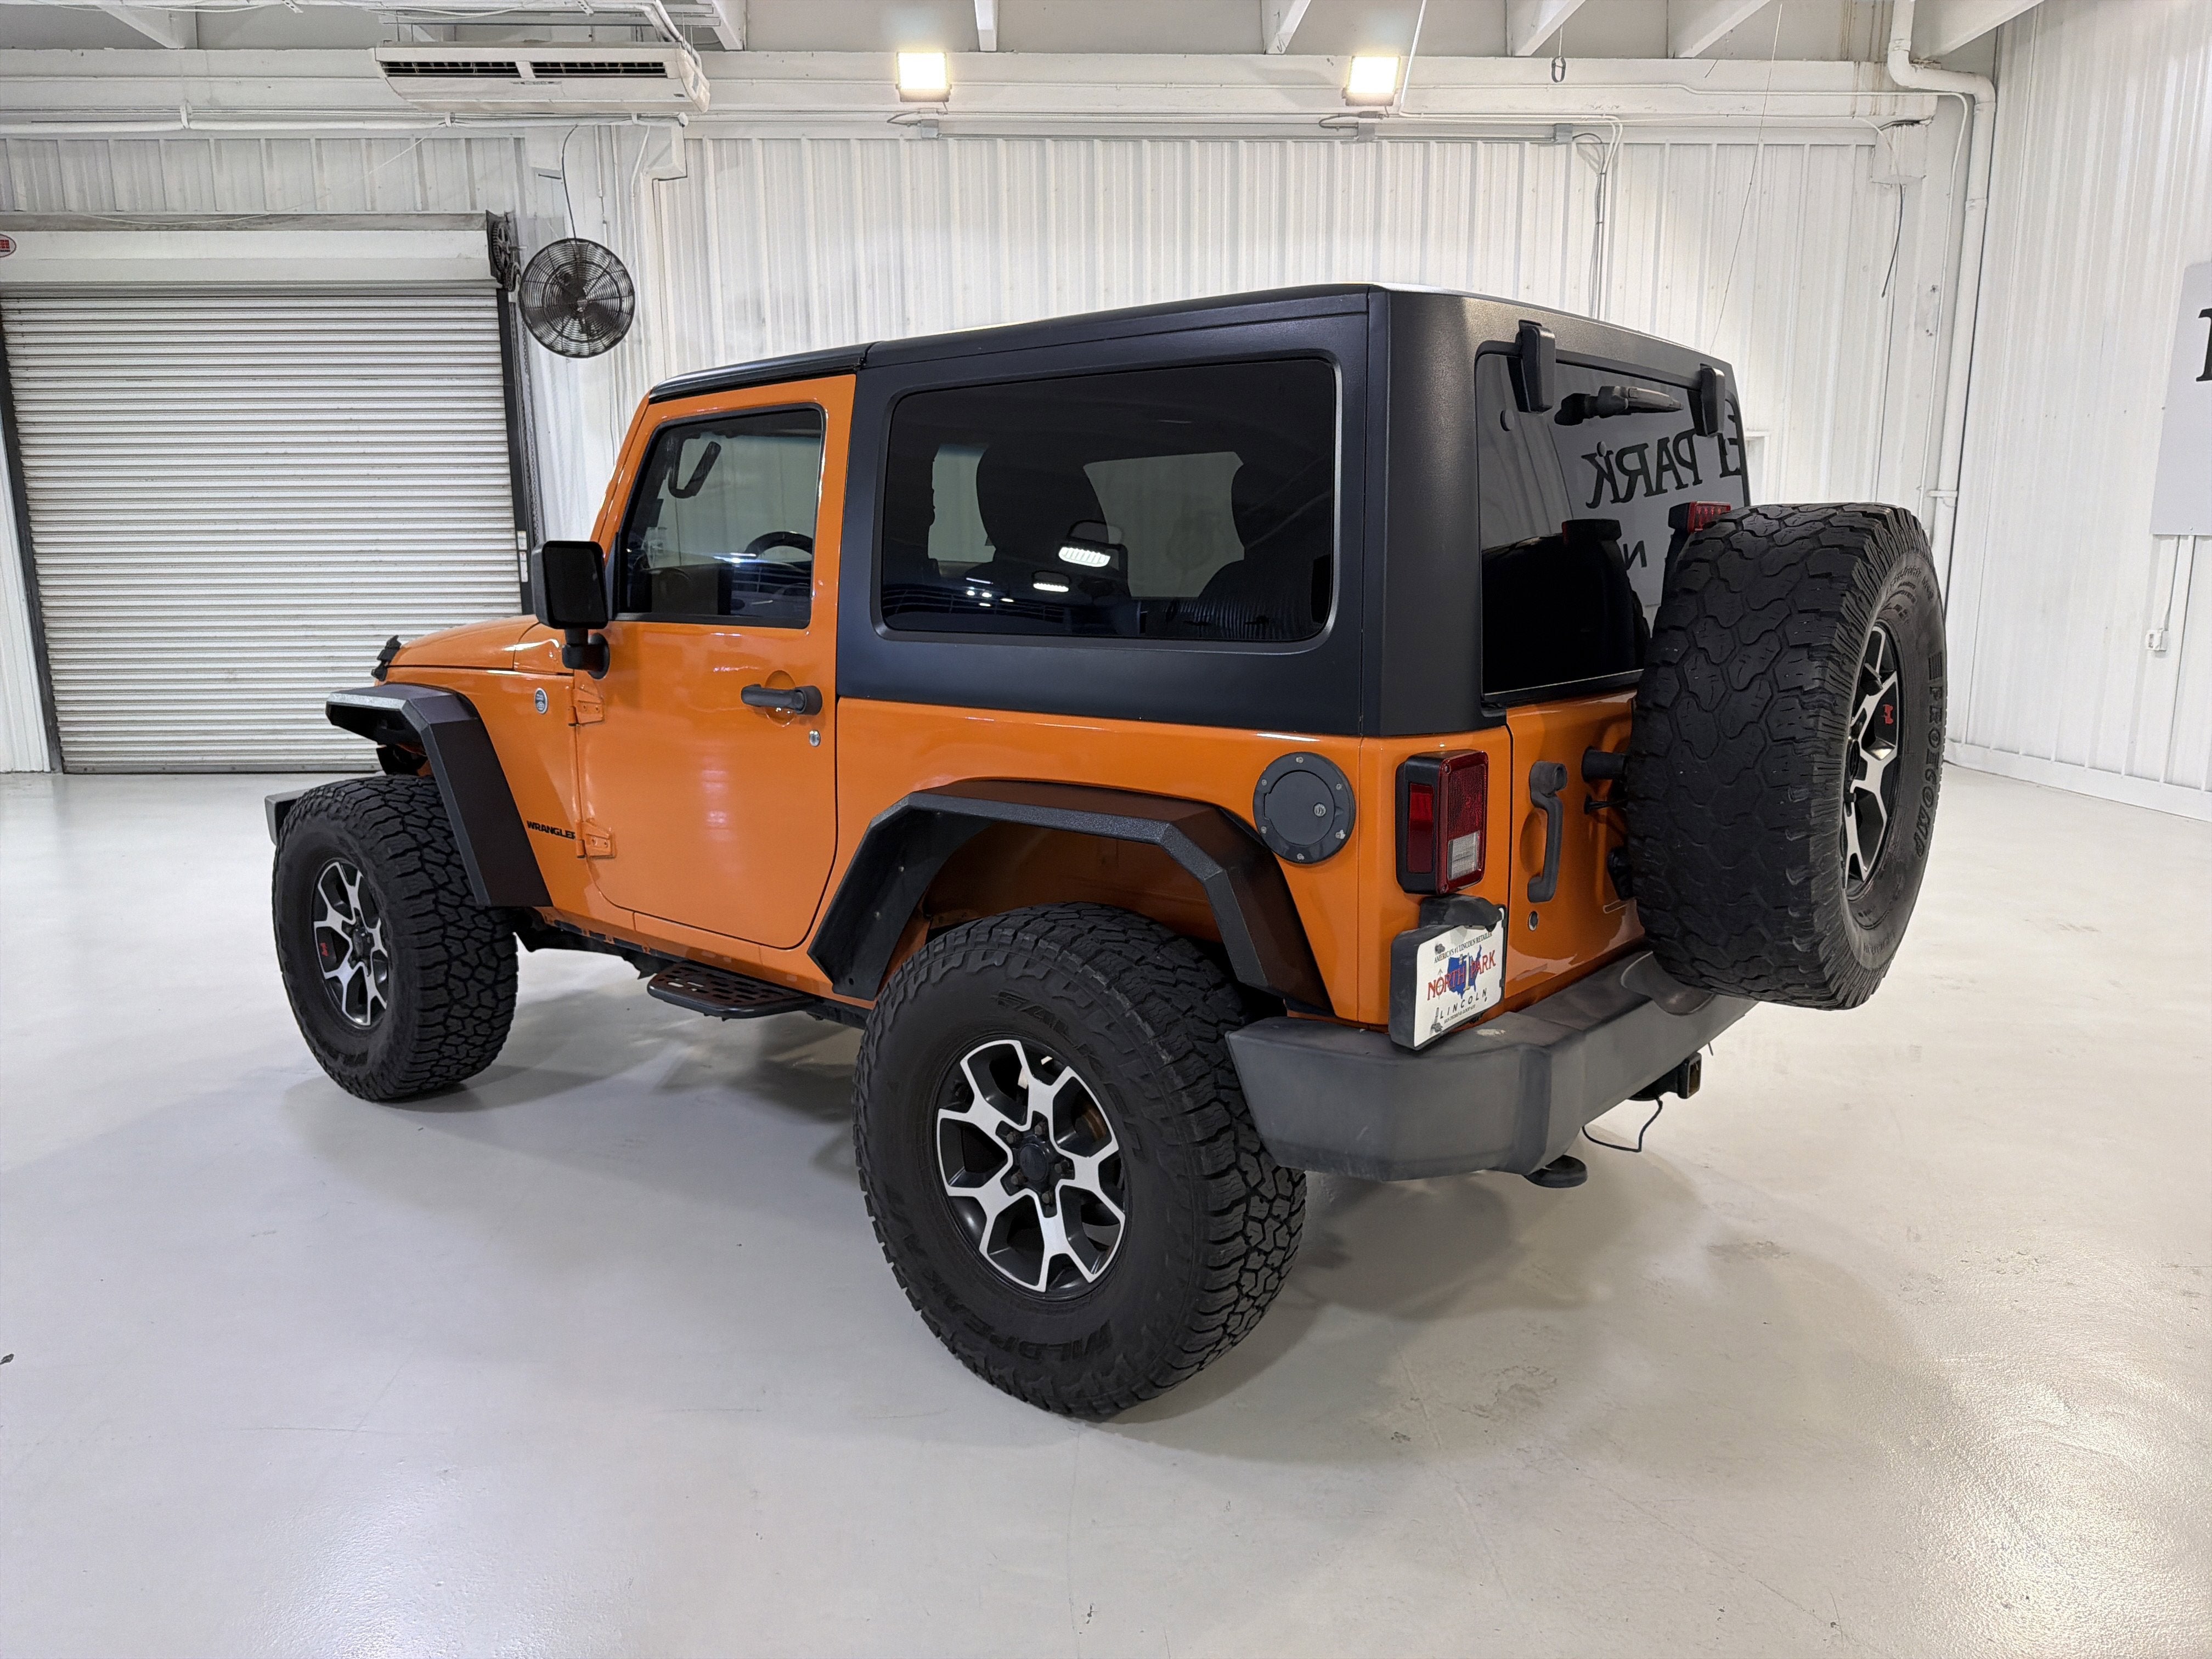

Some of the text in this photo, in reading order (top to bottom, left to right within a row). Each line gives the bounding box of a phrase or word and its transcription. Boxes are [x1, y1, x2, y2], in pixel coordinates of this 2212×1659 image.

[1458, 938, 1476, 952] LINCOLN
[1427, 950, 1497, 1001] NORTH PARK
[1440, 987, 1487, 1019] LINCOLN
